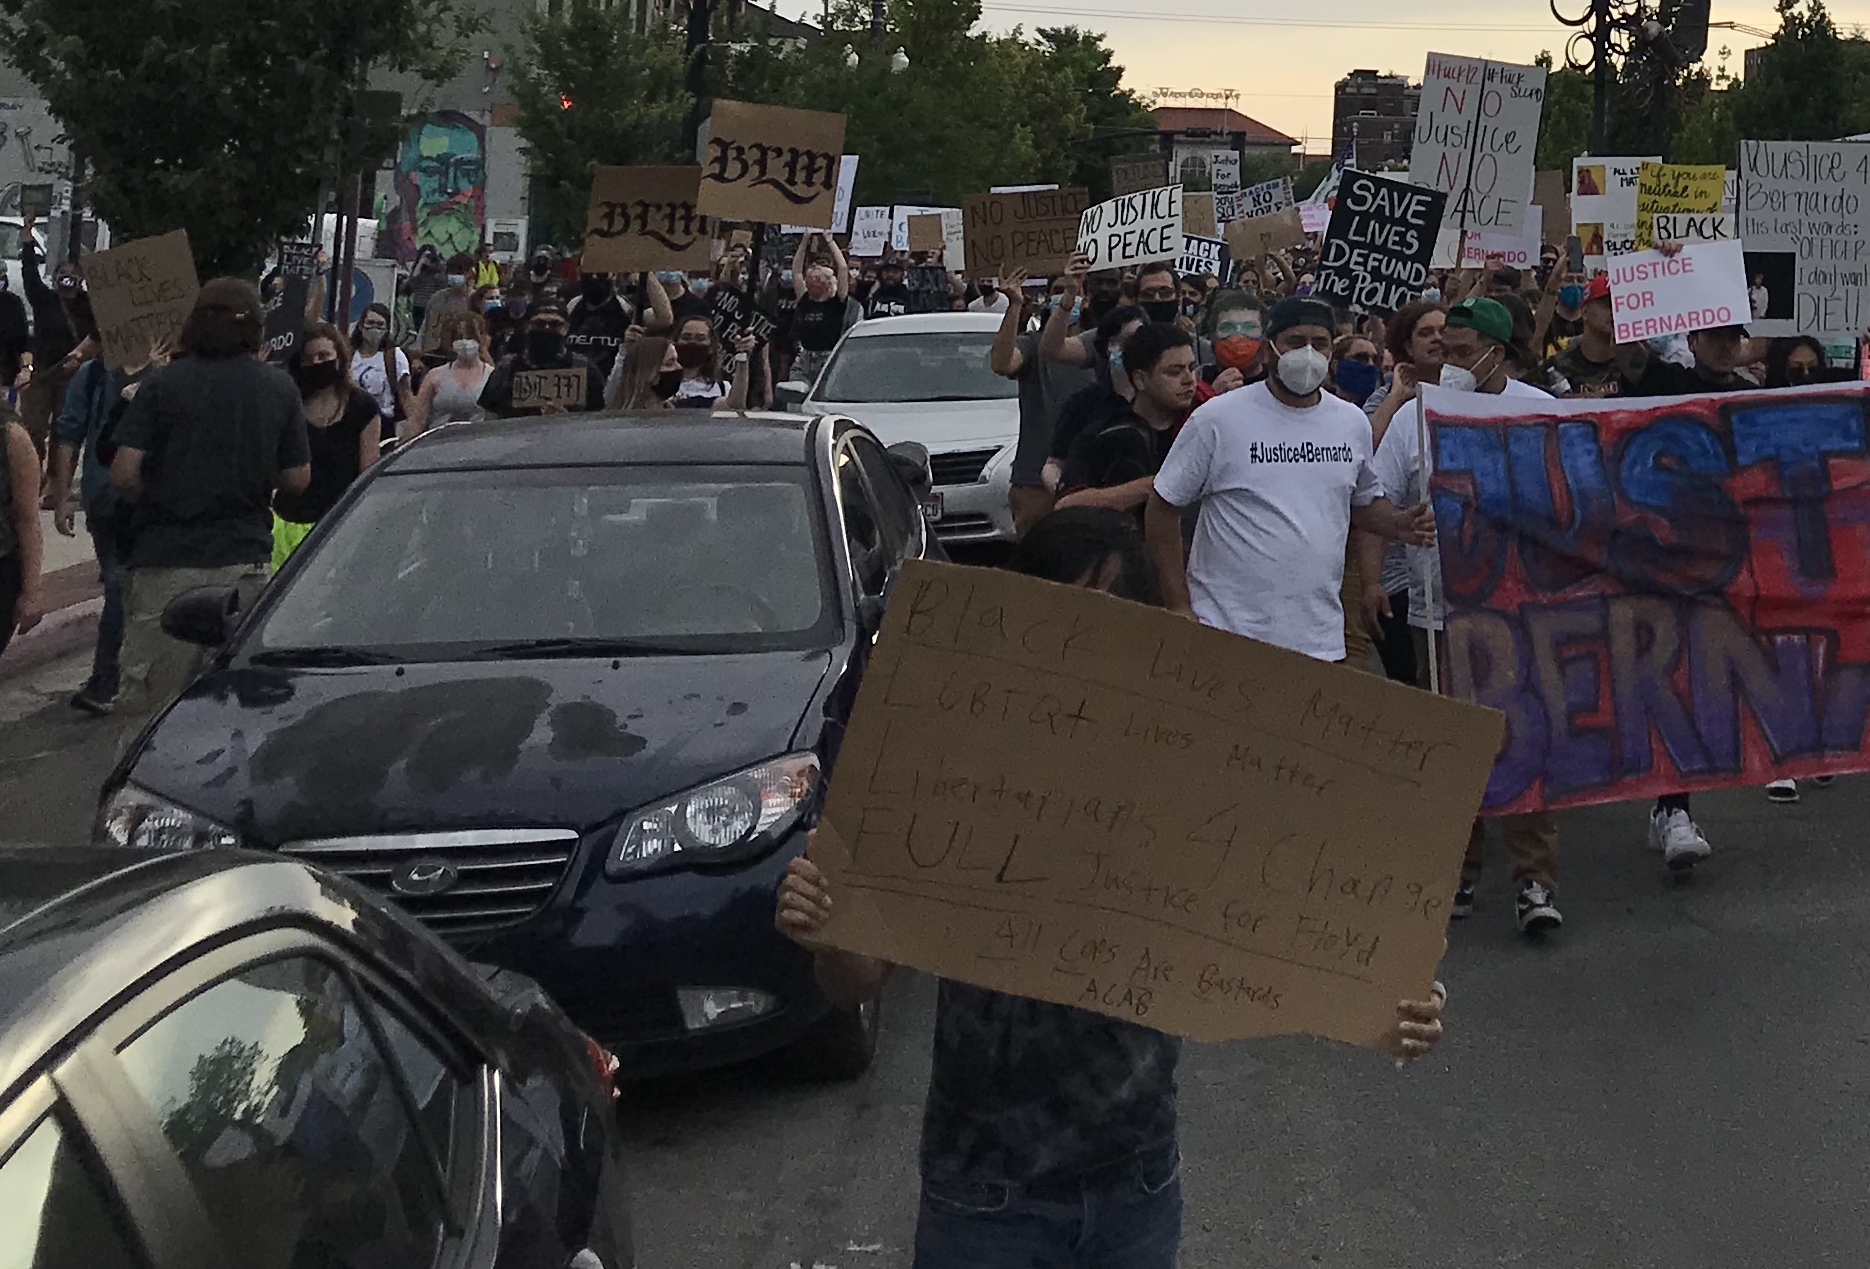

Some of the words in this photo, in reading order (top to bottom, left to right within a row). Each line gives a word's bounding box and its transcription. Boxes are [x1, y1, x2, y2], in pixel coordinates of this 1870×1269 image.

[1441, 86, 1503, 118] NO
[1418, 111, 1522, 155] Justice
[701, 136, 836, 205] BLM
[1435, 151, 1499, 196] NO
[1671, 168, 1699, 187] you
[1856, 154, 1870, 185] 4
[971, 200, 1004, 229] NO
[1014, 191, 1088, 220] JUSTICE
[1251, 191, 1273, 209] NO
[1346, 178, 1432, 226] SAVE
[1694, 184, 1711, 199] in
[1745, 178, 1859, 219] Bernardo
[587, 198, 710, 253] BLM
[1081, 204, 1103, 238] NO
[1107, 186, 1182, 229] JUSTICE
[1656, 215, 1728, 241] BLACK
[1745, 217, 1769, 236] His
[972, 234, 1005, 266] NO
[1012, 226, 1076, 259] PEACE
[1107, 223, 1175, 263] PEACE
[1181, 236, 1222, 261] LACK
[1347, 215, 1420, 255] LIVES
[1321, 238, 1427, 286] DEFUND
[1611, 256, 1695, 286] JUSTICE
[1840, 263, 1869, 287] want
[1614, 290, 1656, 314] FOR
[1617, 305, 1732, 341] BERNARDO
[905, 578, 1081, 663] Black
[1149, 642, 1256, 712] Lives
[1300, 688, 1458, 773] Matter
[884, 657, 1099, 740] LGBTQ+
[1123, 713, 1195, 750] Lives
[1226, 744, 1334, 794] Matter
[851, 805, 1050, 884] FULL
[1078, 850, 1198, 916] Justice
[1222, 898, 1264, 936] for
[1185, 802, 1240, 891] 4
[1260, 832, 1445, 920] Change
[1131, 946, 1176, 985] Are
[1078, 979, 1155, 1017] ACAB
